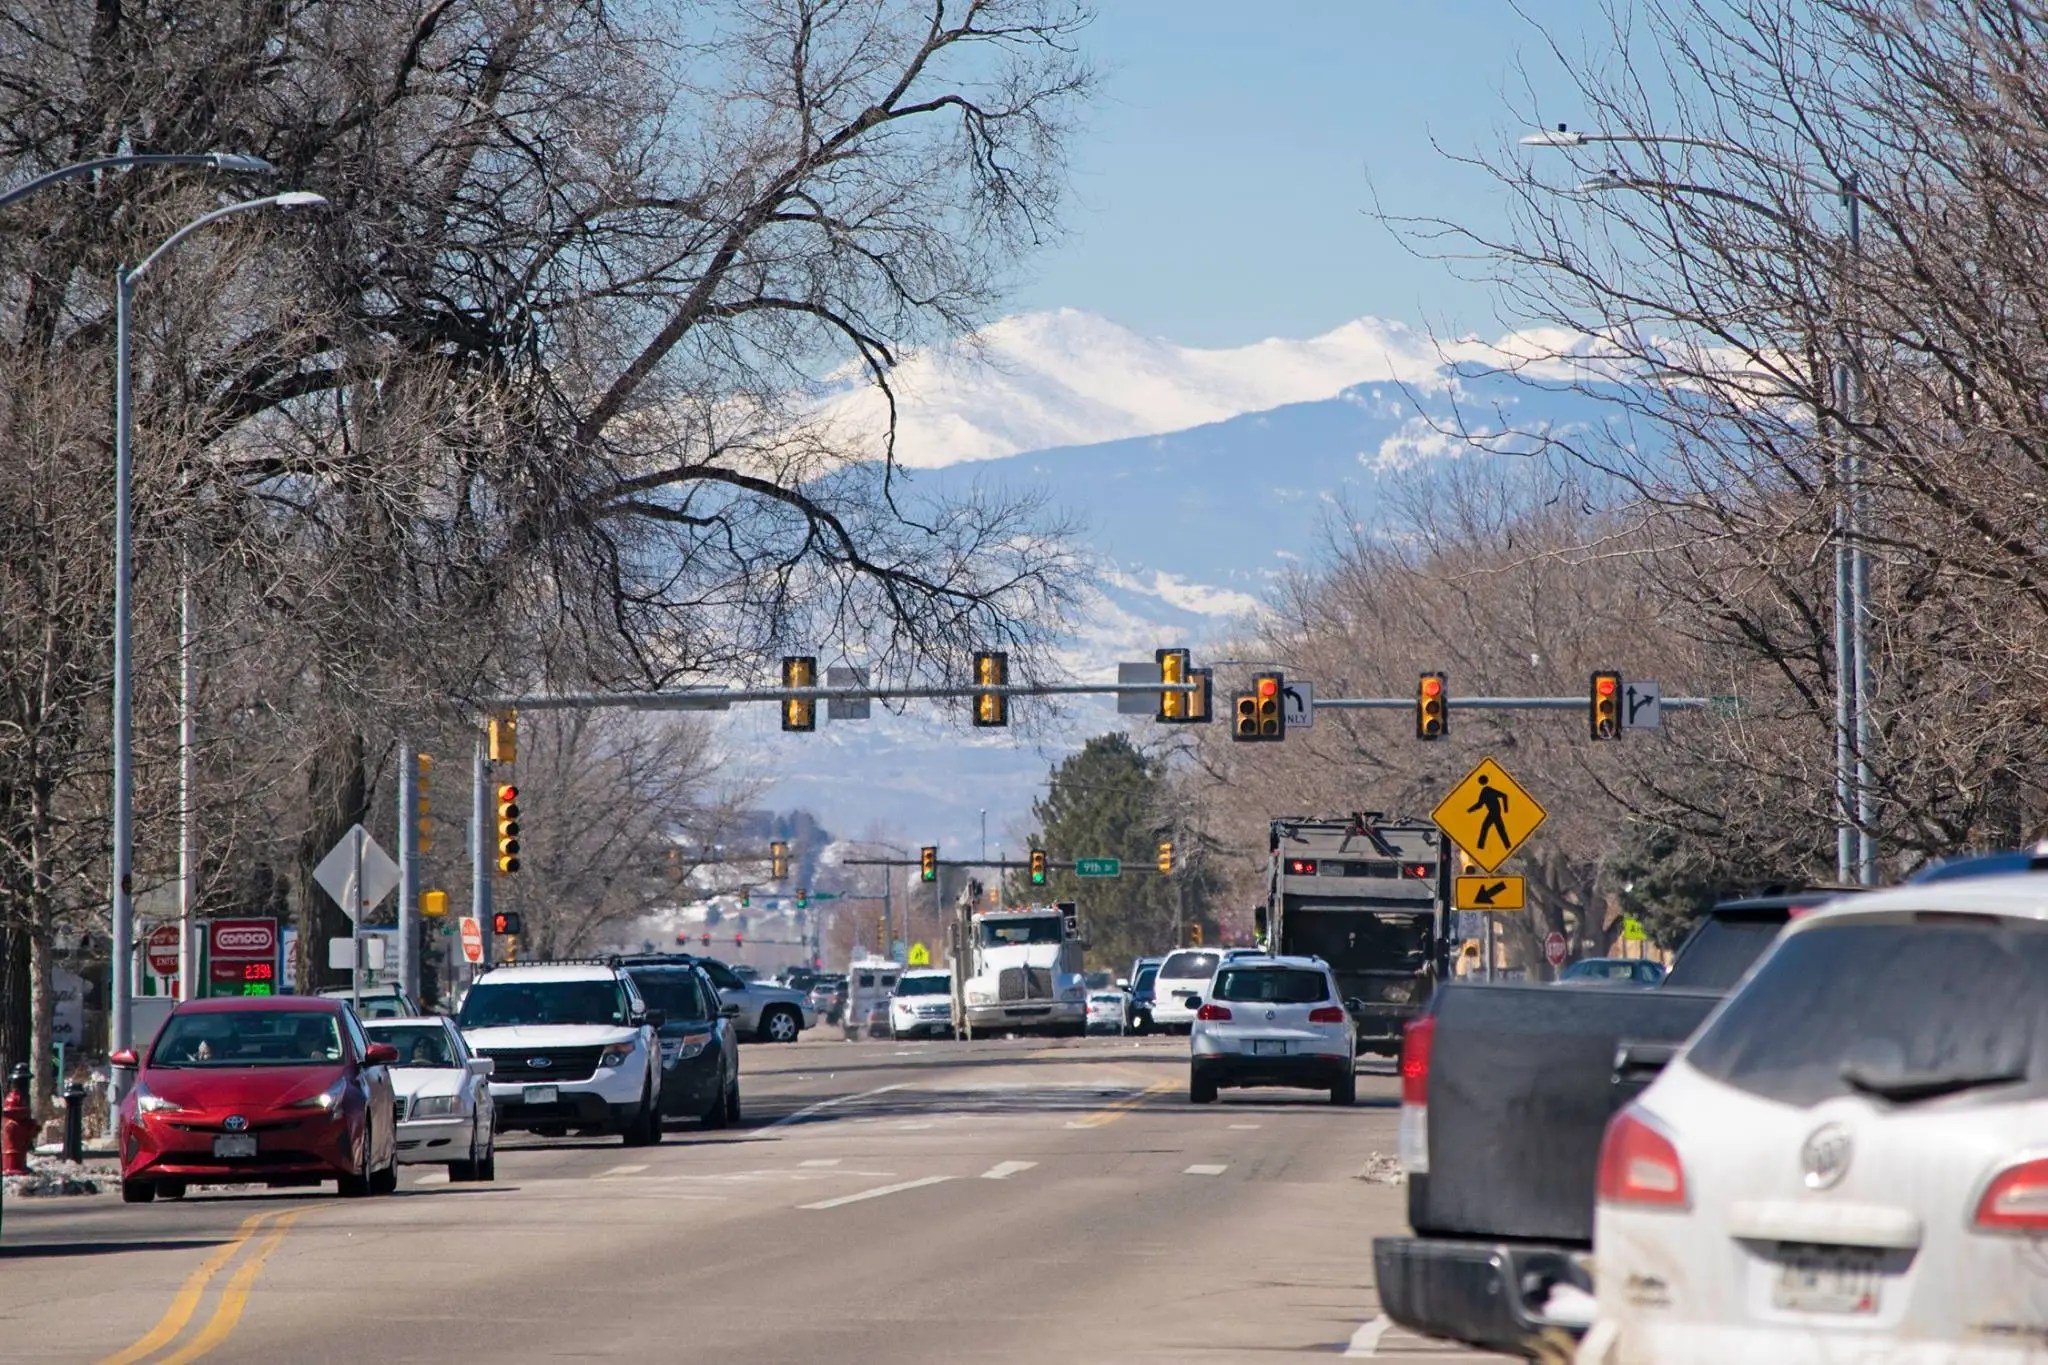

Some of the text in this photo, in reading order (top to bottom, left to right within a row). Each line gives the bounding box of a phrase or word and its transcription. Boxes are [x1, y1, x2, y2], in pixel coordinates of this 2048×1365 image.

[1287, 714, 1307, 724] NLY
[167, 934, 179, 945] NO
[1548, 942, 1563, 956] STOP
[156, 957, 179, 967] ENTE
